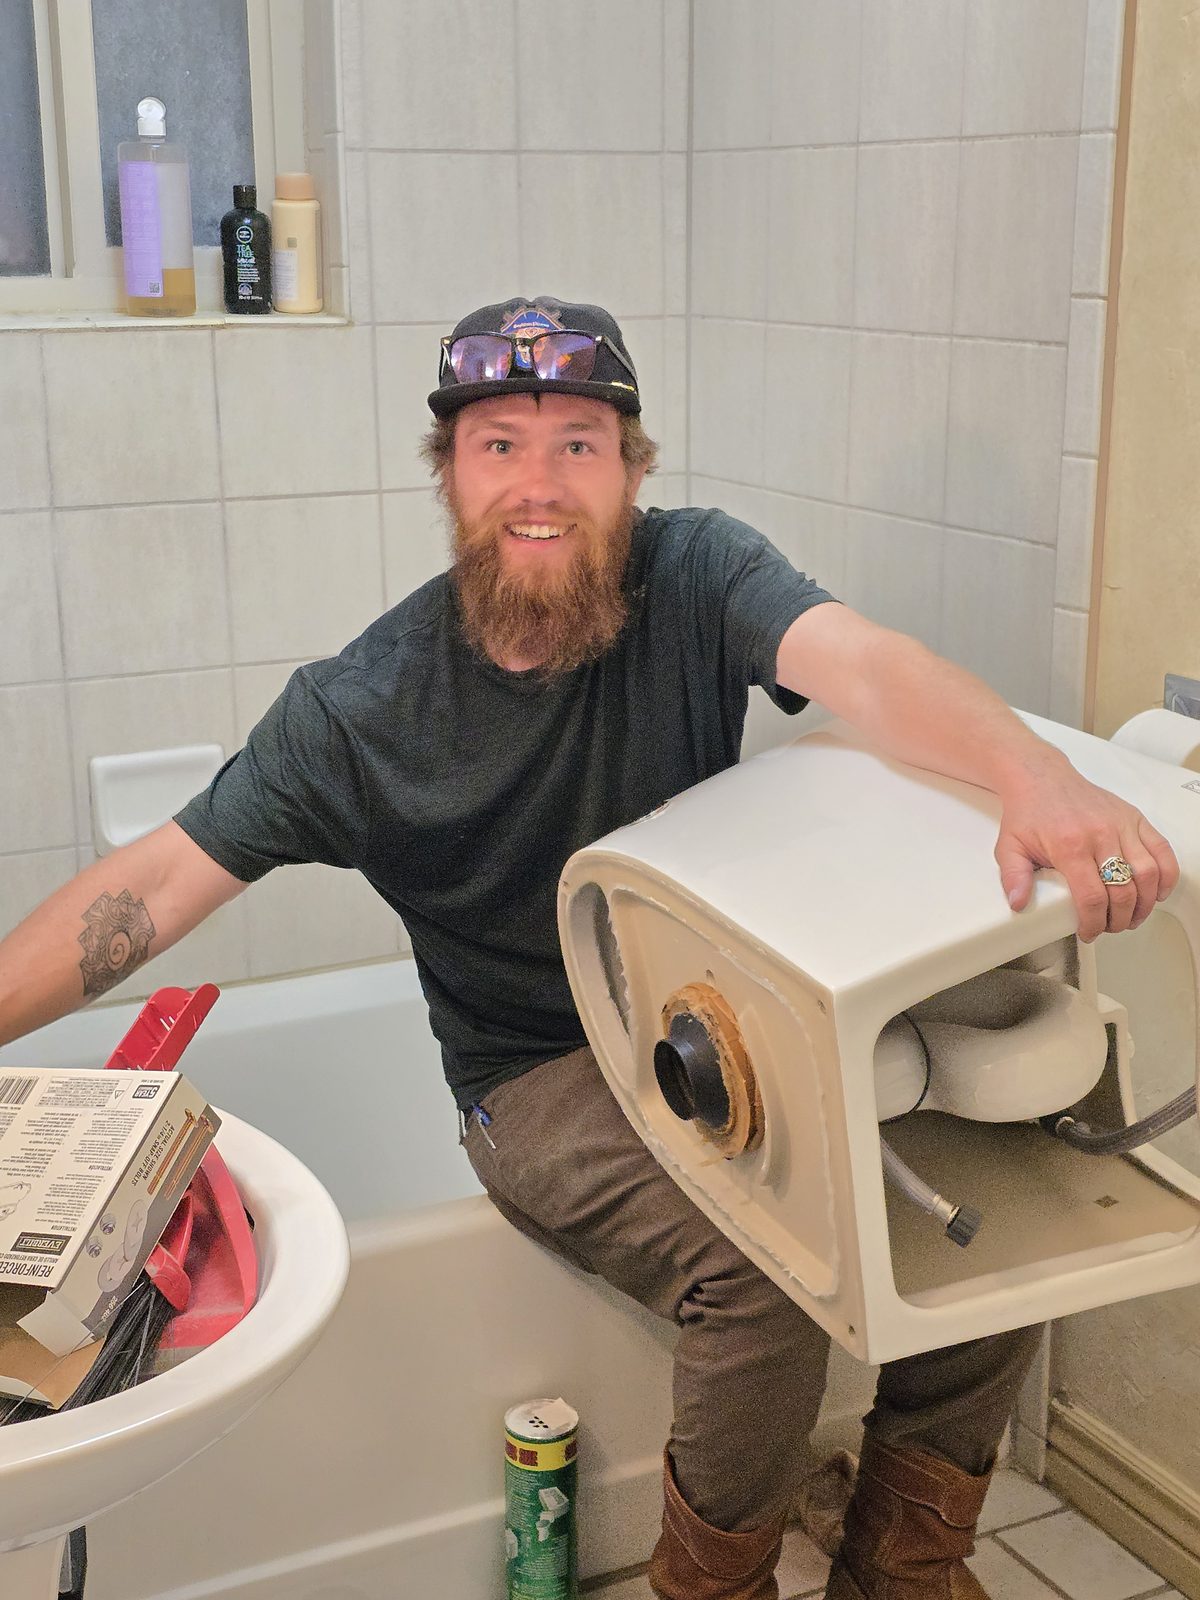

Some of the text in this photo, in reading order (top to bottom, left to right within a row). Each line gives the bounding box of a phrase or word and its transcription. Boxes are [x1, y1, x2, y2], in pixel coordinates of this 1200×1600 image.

[135, 1089, 150, 1097] YEAR
[149, 1087, 158, 1097] 5
[142, 1139, 160, 1166] SNAP-OFF
[142, 1125, 175, 1181] ACTUAL SIZE SHOWN
[131, 1168, 144, 1187] BOLTS
[20, 1238, 63, 1249] EVERBILT
